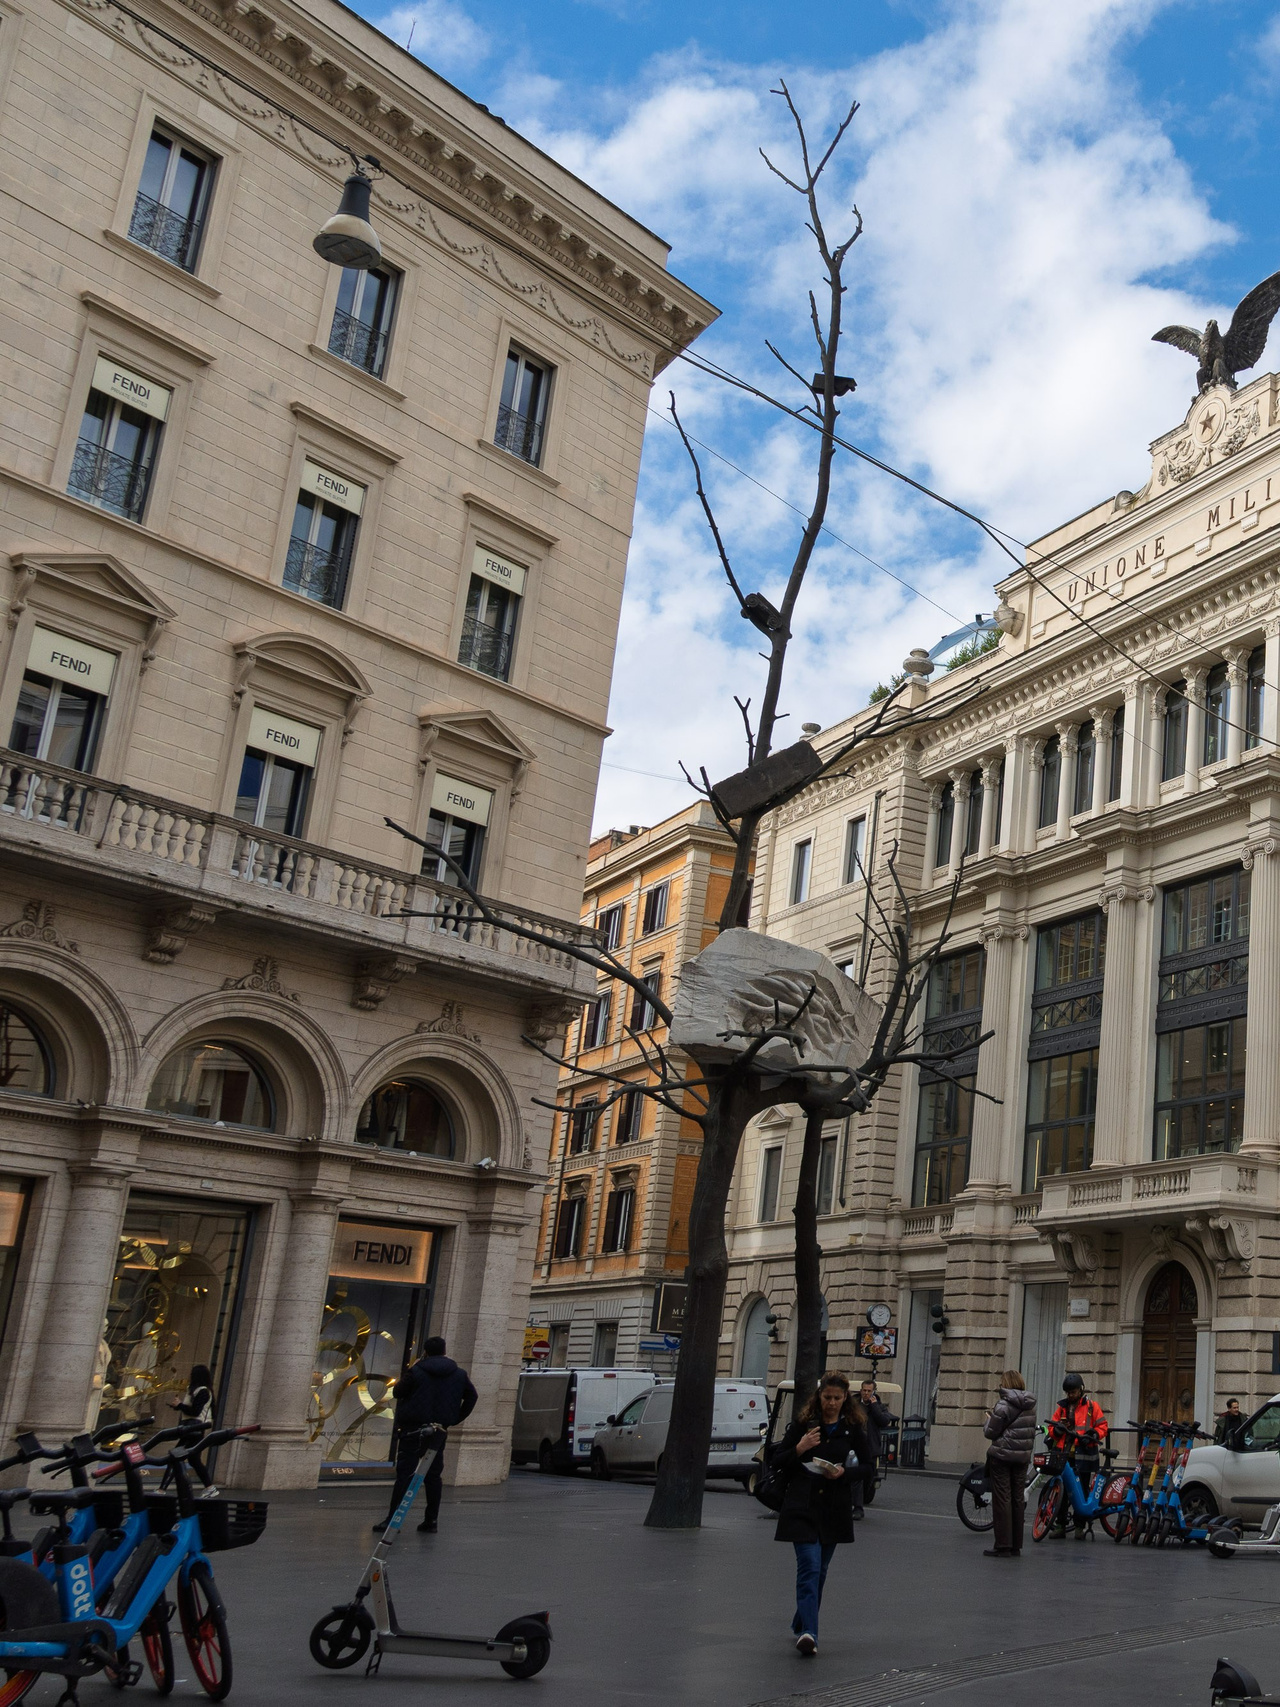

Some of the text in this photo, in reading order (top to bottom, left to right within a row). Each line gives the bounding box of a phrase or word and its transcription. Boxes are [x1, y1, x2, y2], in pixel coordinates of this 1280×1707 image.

[113, 373, 150, 400] FENDI
[317, 473, 349, 496] FENDI
[486, 558, 512, 579] FENDI
[1068, 535, 1165, 602] UNIONE
[50, 651, 92, 676] FENDI
[266, 728, 301, 750] FENDI
[446, 791, 476, 811] FENDI
[353, 1240, 413, 1266] FENDI
[331, 1467, 355, 1475] FENDI
[1094, 1478, 1106, 1499] dott
[394, 1489, 414, 1523] BIRD
[69, 1562, 93, 1619] dott
